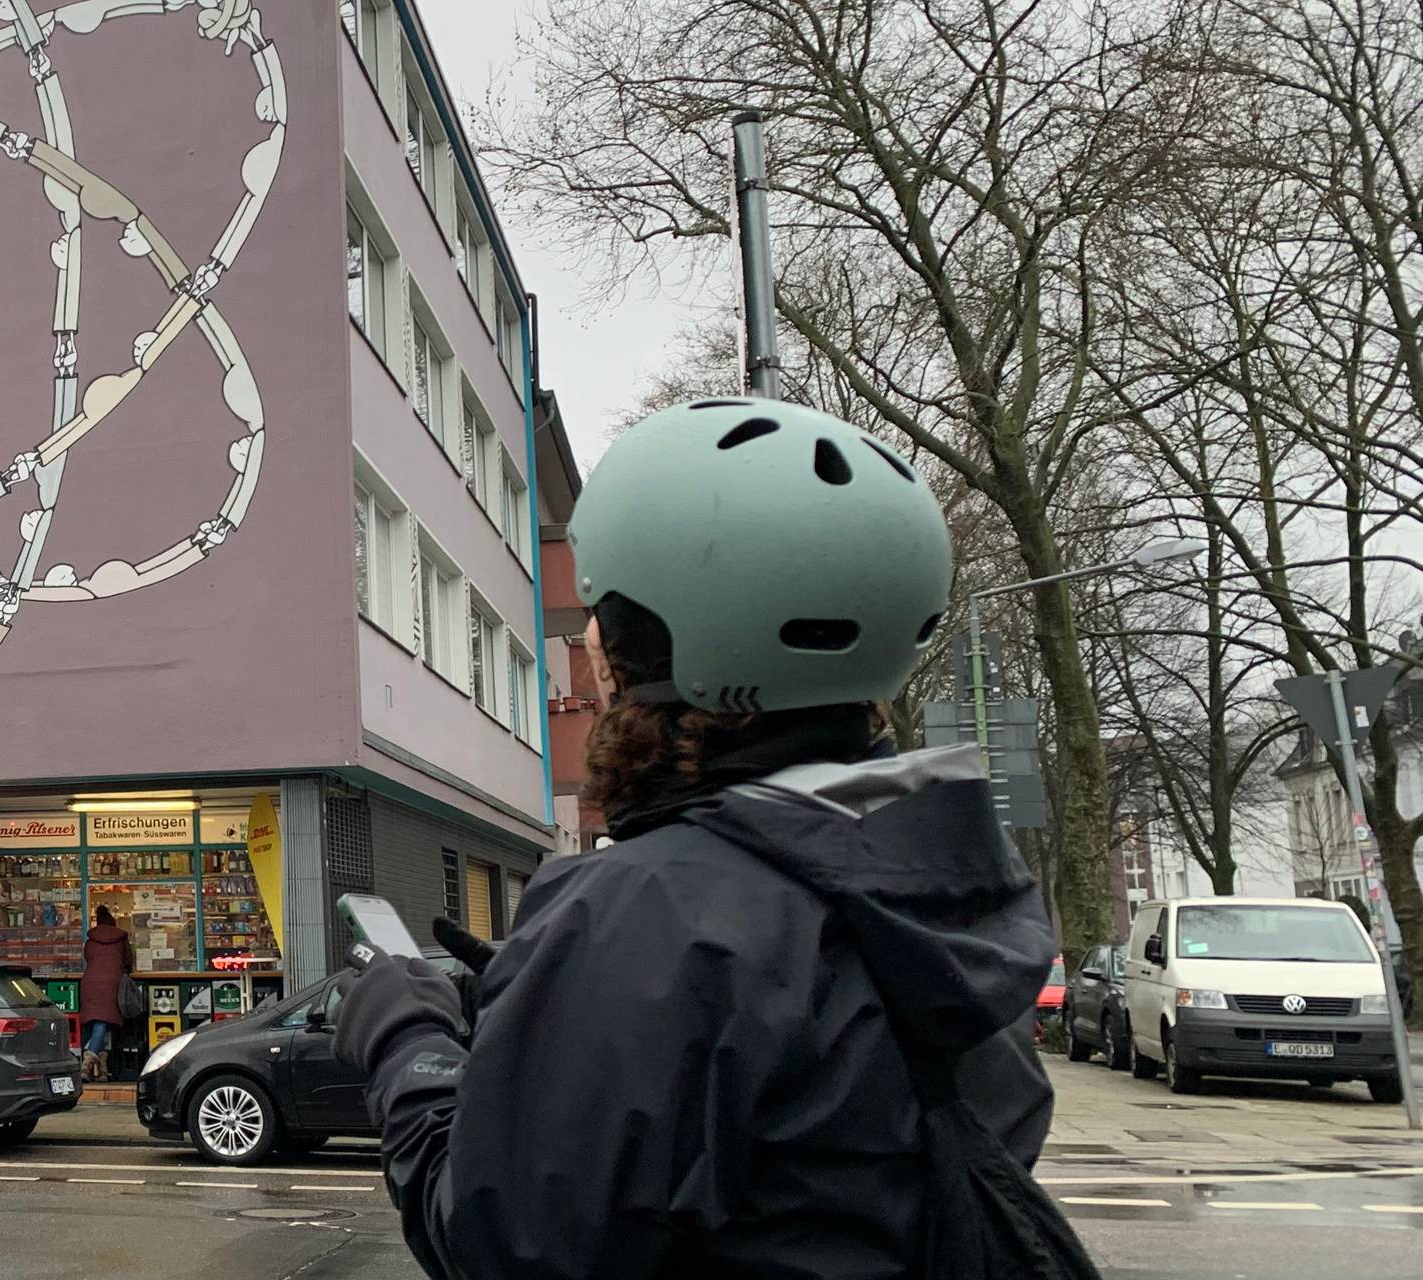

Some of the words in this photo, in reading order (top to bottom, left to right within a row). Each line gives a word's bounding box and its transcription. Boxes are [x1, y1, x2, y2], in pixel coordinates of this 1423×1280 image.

[93, 816, 187, 829] Erfrischungen
[94, 831, 141, 839] Tabakwaren
[144, 830, 187, 838] Süsswaren
